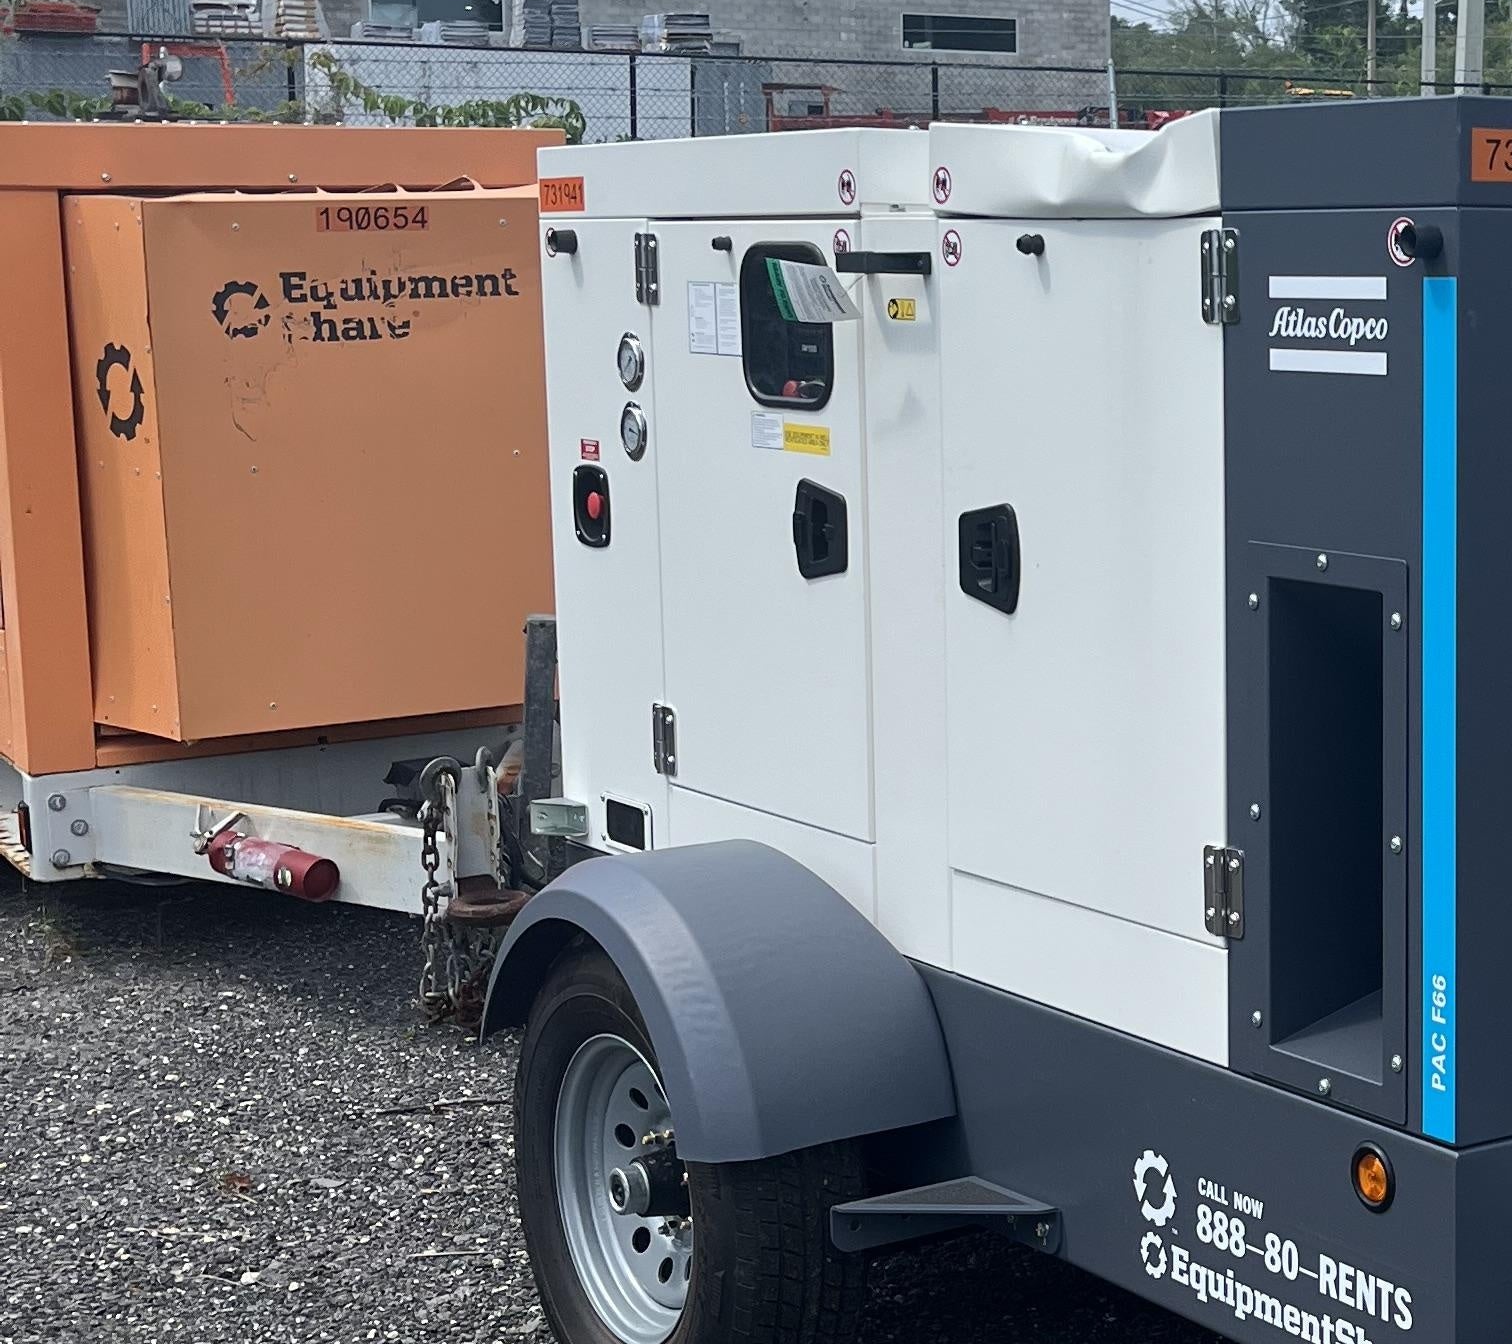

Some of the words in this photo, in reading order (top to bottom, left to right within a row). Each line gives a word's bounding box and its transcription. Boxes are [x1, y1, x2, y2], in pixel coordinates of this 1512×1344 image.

[543, 183, 583, 205] 731941
[319, 207, 428, 230] 190654
[279, 269, 520, 309] Equipment
[1269, 306, 1326, 339] Atlas
[1328, 308, 1388, 345] Copco
[1431, 974, 1447, 1025] F66
[1431, 1032, 1447, 1092] PAC
[1198, 1177, 1229, 1205] CALL
[1233, 1191, 1264, 1219] NOW
